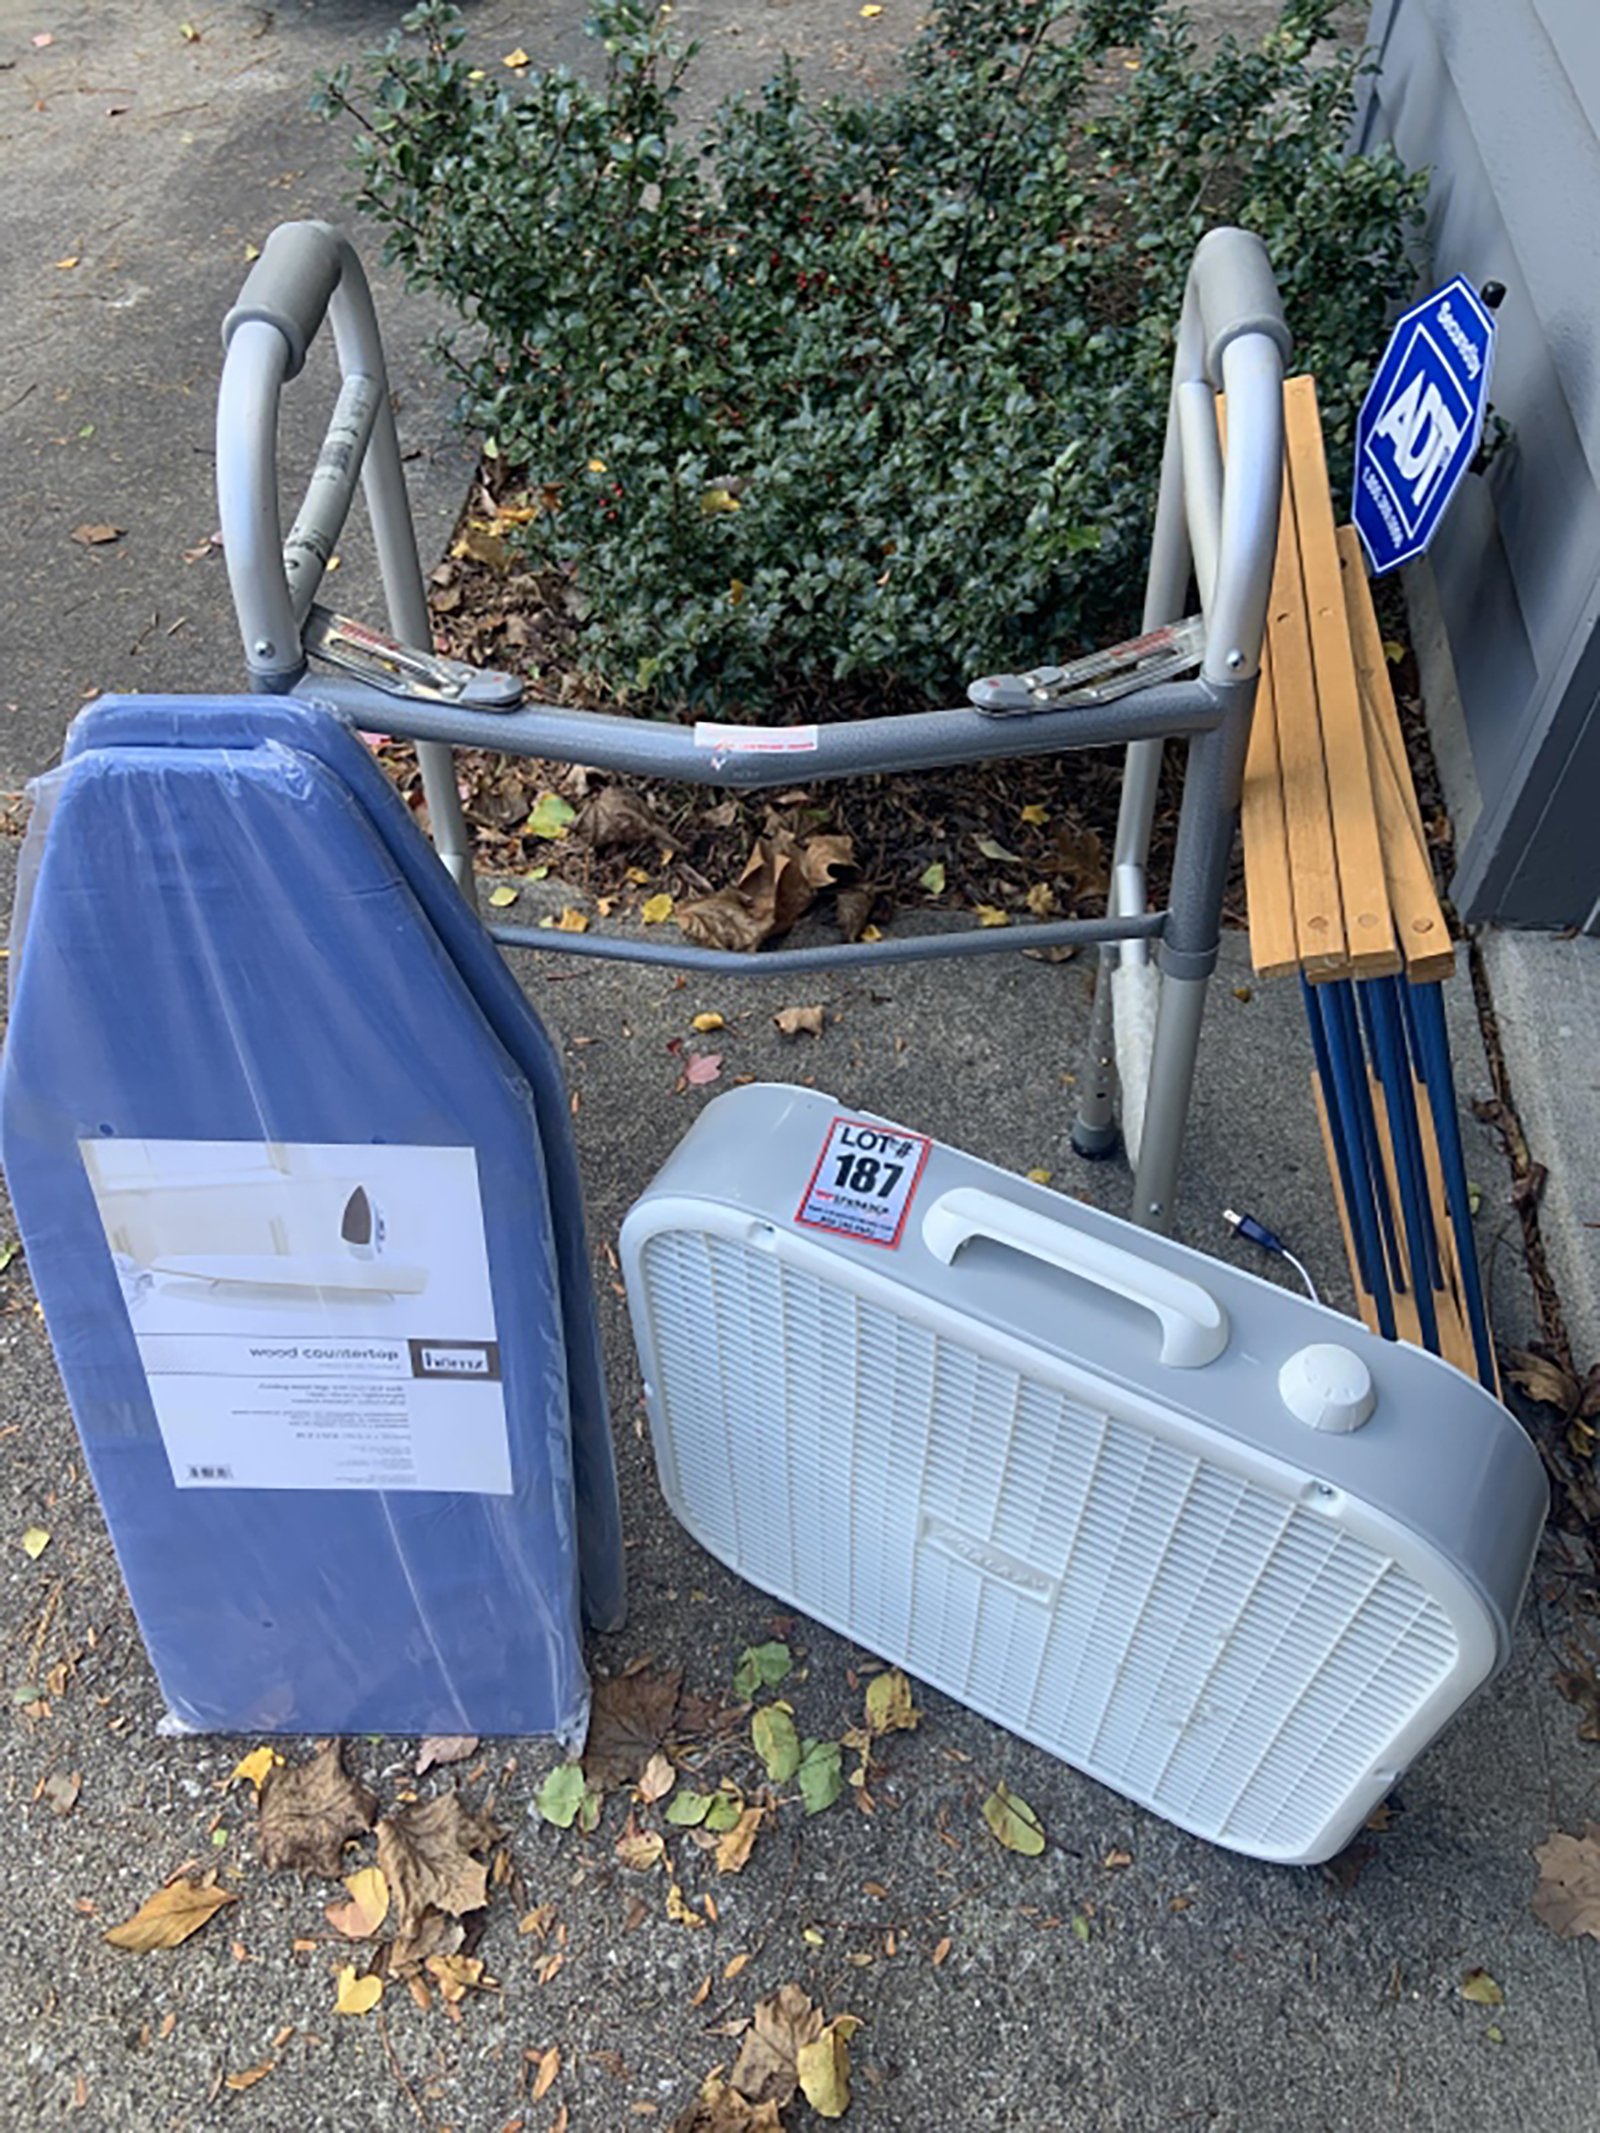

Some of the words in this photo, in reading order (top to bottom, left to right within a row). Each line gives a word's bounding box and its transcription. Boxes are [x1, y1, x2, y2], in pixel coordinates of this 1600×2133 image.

[1376, 369, 1461, 507] ADT
[834, 1153, 904, 1199] 187
[250, 1347, 298, 1359] wood
[302, 1349, 398, 1361] countertop
